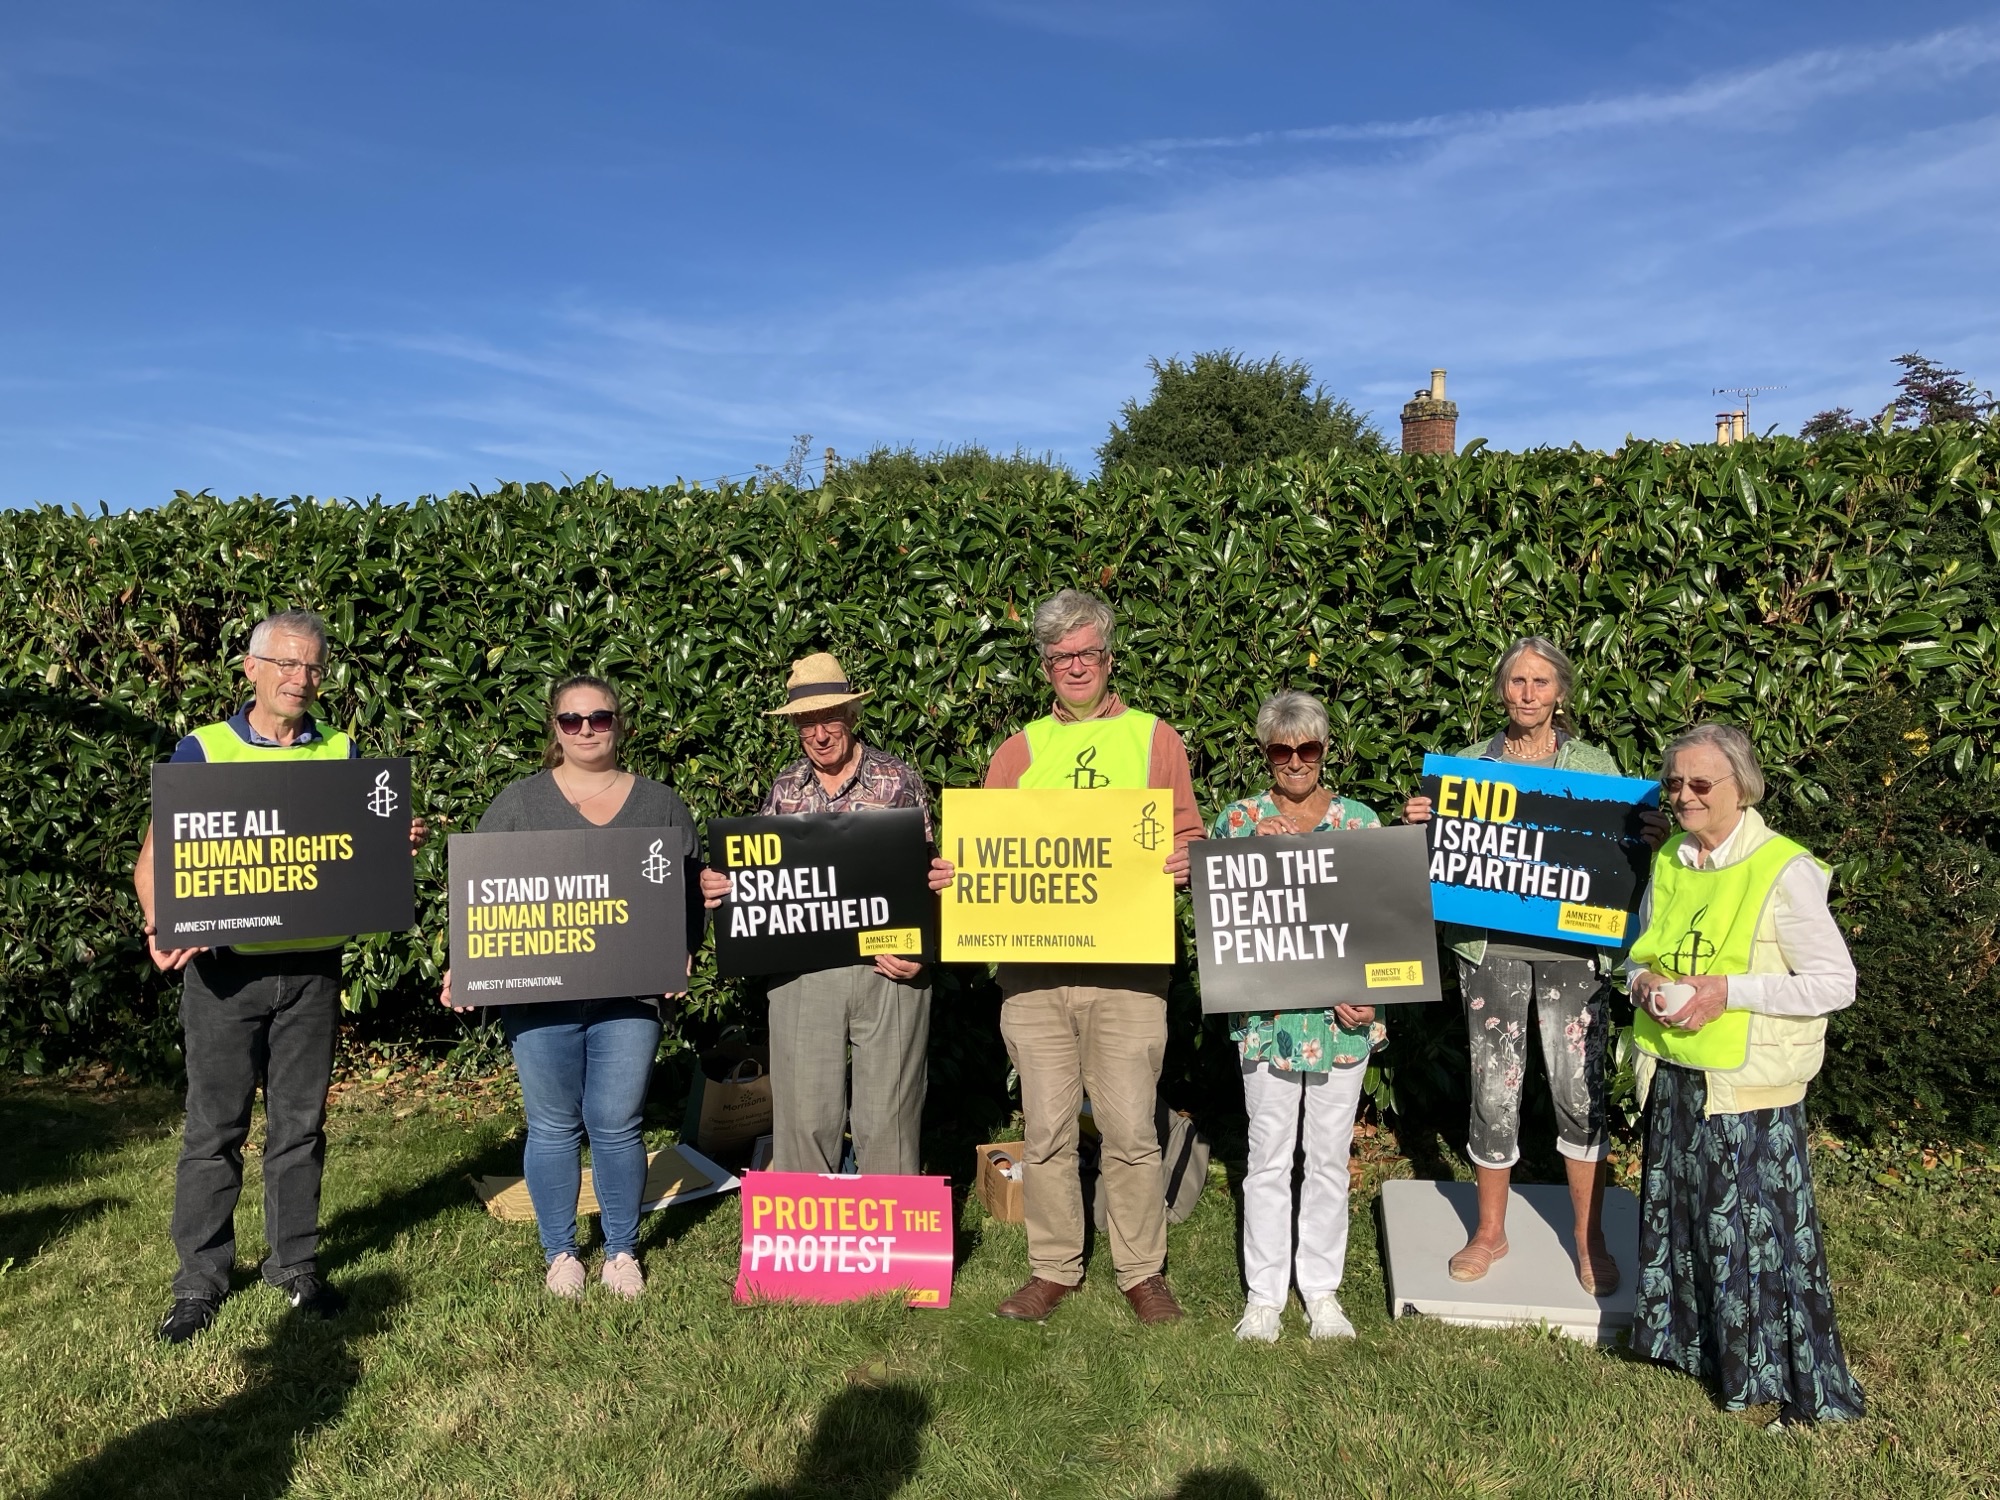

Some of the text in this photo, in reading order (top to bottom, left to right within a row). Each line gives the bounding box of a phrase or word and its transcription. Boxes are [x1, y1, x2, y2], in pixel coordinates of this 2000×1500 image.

[1438, 775, 1517, 824] END
[173, 809, 286, 841] FREE ALL
[1434, 817, 1543, 862] ISRAELI
[174, 834, 353, 869] HUMAN RIGHTS
[726, 834, 781, 867] END
[958, 837, 1112, 868] I WELCOME
[174, 864, 318, 899] DEFENDERS
[730, 866, 837, 902] ISRAELI
[1206, 848, 1338, 890] END THE
[1430, 851, 1590, 902] APARTHEID
[467, 874, 609, 904] I STAND WITH
[957, 873, 1098, 904] REFUGEES
[174, 916, 283, 933] AMNESTY INTERNATIONAL
[468, 899, 629, 932] HUMAN RIGHTS
[730, 897, 888, 937] APARTHEID
[1210, 888, 1307, 928] DEATH
[1565, 910, 1602, 924] AMNESTY
[1565, 919, 1601, 929] INTERNATIONAL
[468, 928, 596, 959] DEFENDERS
[865, 935, 898, 945] AMNESTY
[957, 934, 1096, 947] AMNESTY INTERNATIONAL
[1213, 924, 1349, 965] PENALTY
[467, 976, 563, 991] AMNESTY INTERNATIONAL
[1371, 968, 1401, 977] AMNESTY
[722, 1096, 767, 1111] Morrisons
[752, 1196, 941, 1232] PROTECT THE
[751, 1235, 896, 1273] PROTEST
